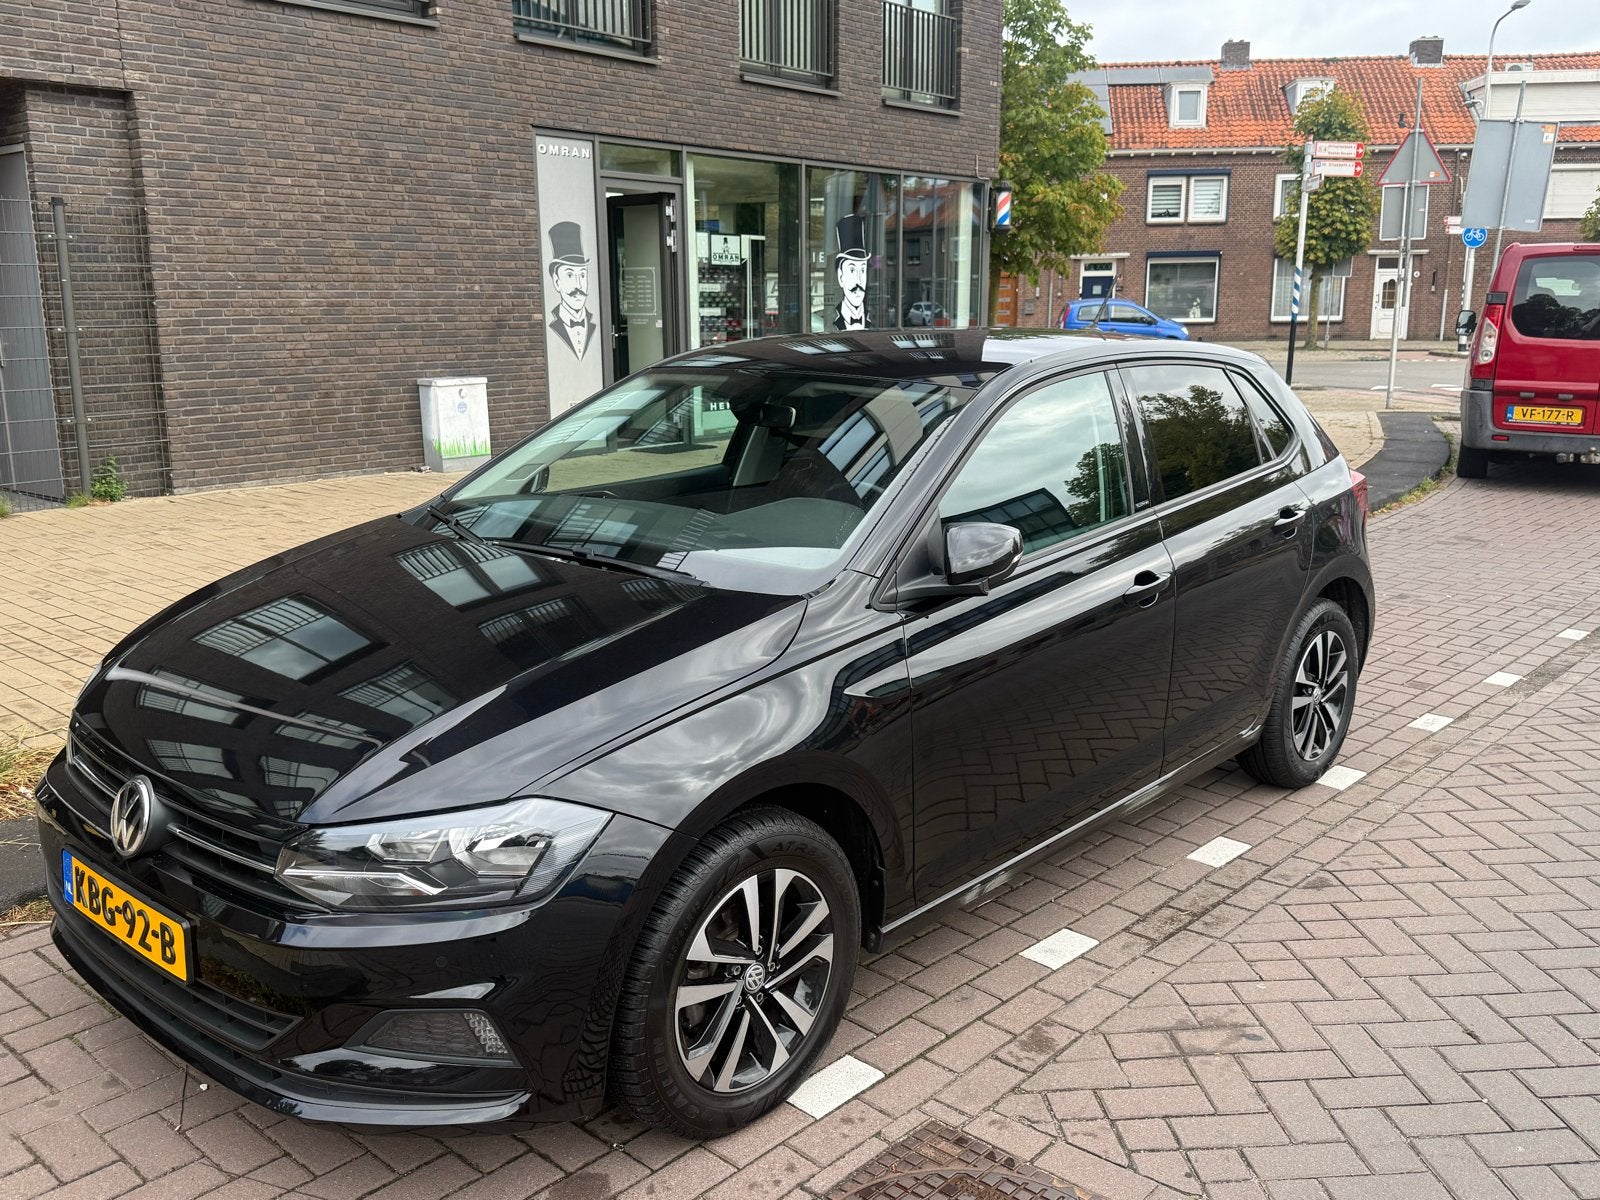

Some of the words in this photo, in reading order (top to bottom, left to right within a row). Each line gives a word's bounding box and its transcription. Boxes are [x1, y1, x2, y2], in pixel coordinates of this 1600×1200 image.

[538, 144, 590, 158] OMRAN
[1521, 408, 1574, 421] VF-177-R
[74, 865, 176, 965] KBG-92-B
